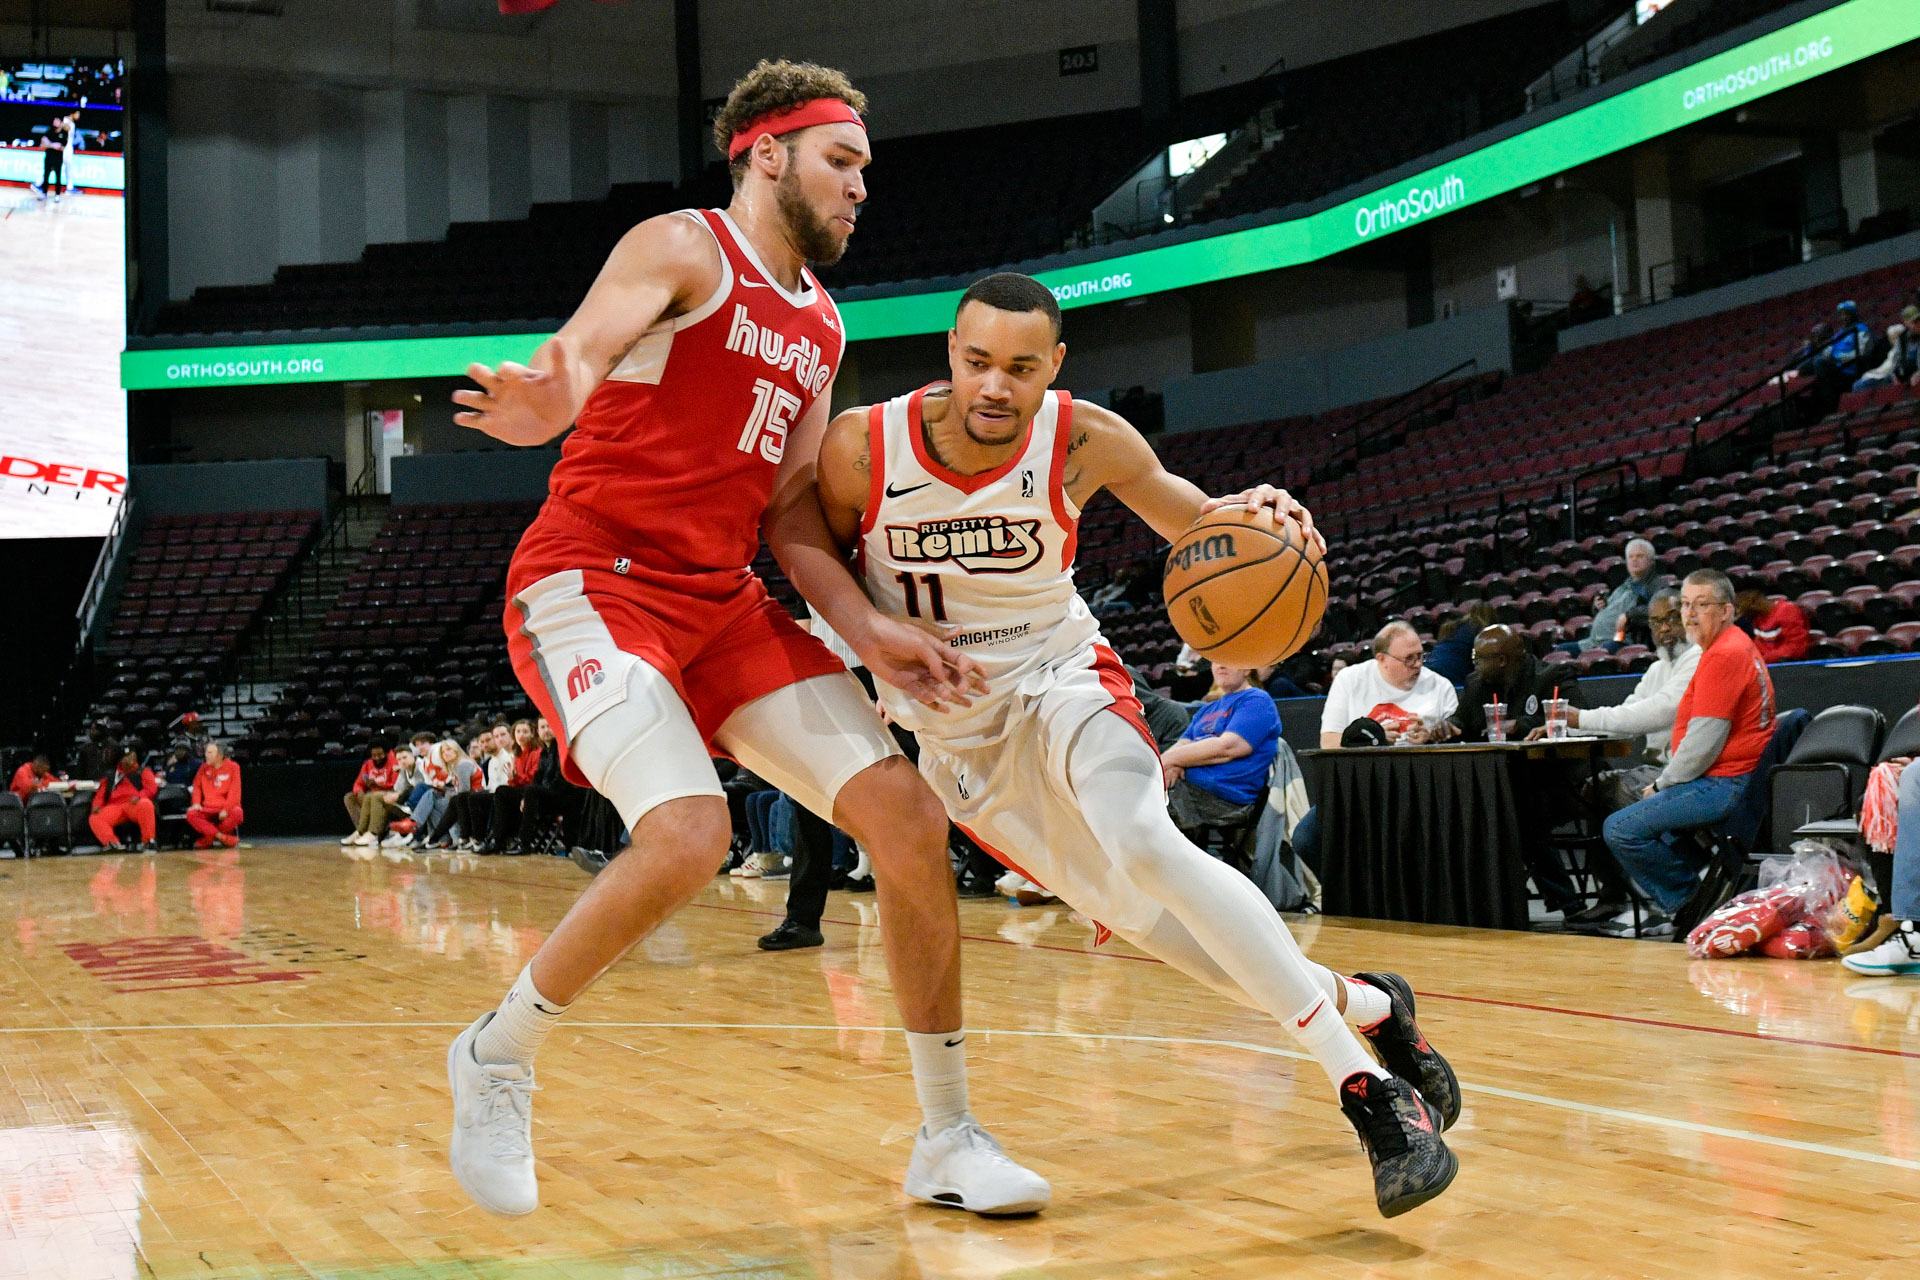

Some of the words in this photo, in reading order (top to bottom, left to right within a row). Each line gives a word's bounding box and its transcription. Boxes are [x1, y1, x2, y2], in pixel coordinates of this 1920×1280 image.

[1682, 35, 1833, 110] ORTHOSOUTH.ORG
[1355, 174, 1465, 237] OrthoSouth
[1050, 272, 1132, 301] SOUTH.ORG
[166, 358, 324, 379] ORTHOSOUTH.ORG
[725, 303, 830, 398] hustle
[737, 377, 802, 465] 15
[888, 518, 1040, 569] Remix
[921, 523, 949, 533] RIP
[951, 519, 987, 531] CITY
[895, 571, 948, 621] 11
[950, 622, 1031, 648] BRIGHTSIDE
[987, 631, 1029, 647] WINDOWS
